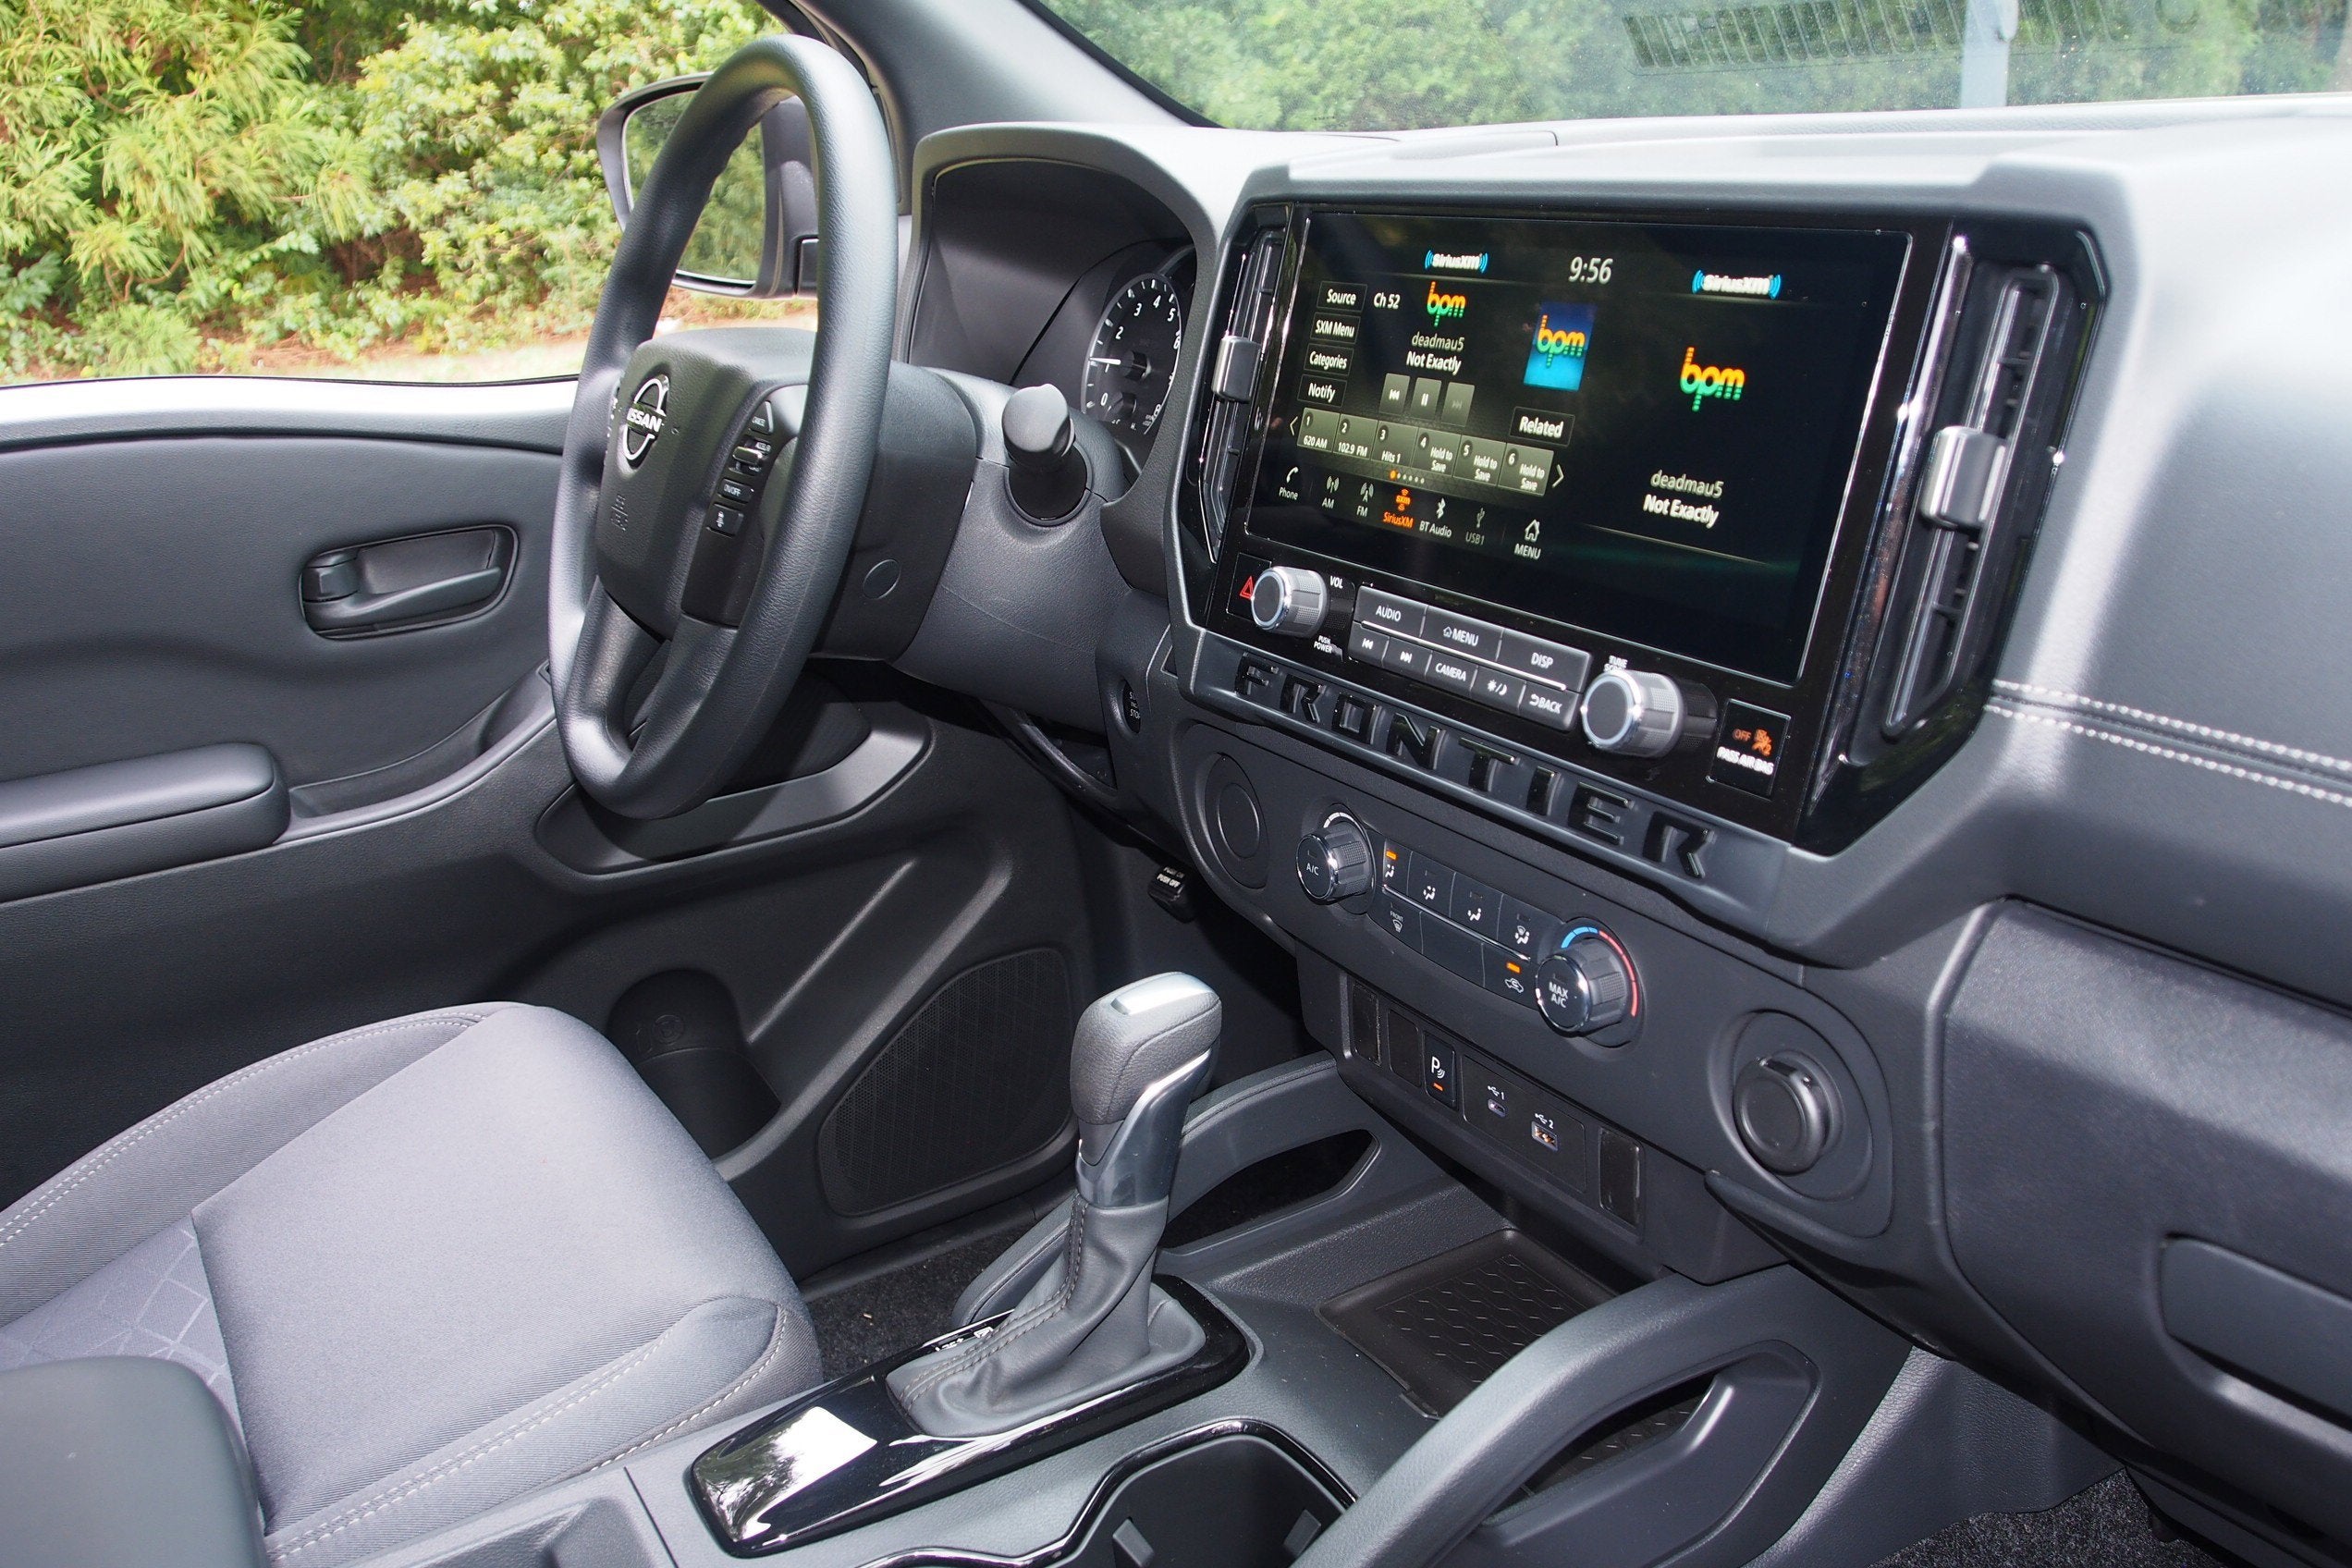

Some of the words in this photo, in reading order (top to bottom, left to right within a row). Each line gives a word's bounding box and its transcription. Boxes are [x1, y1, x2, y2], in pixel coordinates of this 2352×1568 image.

[1568, 256, 1613, 285] 9:56
[1152, 295, 1161, 309] 4
[1326, 288, 1357, 306] Source
[1373, 292, 1387, 307] Ch
[1387, 294, 1401, 310] 52
[1427, 281, 1467, 327] bpm
[1133, 302, 1142, 316] 3
[1167, 307, 1176, 322] 5
[1115, 325, 1123, 339] 2
[1315, 319, 1333, 334] SXM
[1333, 322, 1355, 337] Menu
[1173, 336, 1181, 349] 6
[1411, 331, 1464, 351] deadmau5
[1536, 314, 1586, 368] bpm
[1309, 350, 1347, 371] Categories
[1406, 351, 1427, 368] Not
[1427, 353, 1462, 375] Exactly
[1680, 346, 1746, 412] bpm
[1100, 392, 1109, 406] 0
[1307, 382, 1336, 400] Notify
[1305, 415, 1311, 426] 1
[1341, 423, 1348, 434] 2
[1519, 415, 1564, 440] Related
[1303, 435, 1316, 447] 620
[1315, 437, 1328, 449] AM
[1379, 429, 1386, 440] 3
[1420, 436, 1427, 448] 4
[1338, 442, 1355, 454] 102.9
[1356, 445, 1368, 458] FM
[1381, 450, 1396, 463] Hits
[1396, 453, 1401, 464] 1
[1430, 447, 1446, 459] Hold
[1445, 449, 1453, 461] to
[1463, 444, 1470, 457] 5
[1430, 459, 1447, 472] Save
[1473, 454, 1489, 469] Hold
[1488, 458, 1498, 470] to
[1508, 452, 1515, 465] 6
[1474, 469, 1491, 482] Save
[1519, 463, 1537, 477] Hold
[1536, 467, 1546, 480] to
[1520, 477, 1538, 492] Save
[1650, 469, 1724, 498] deadmau5
[1279, 486, 1299, 500] Phone
[1321, 497, 1335, 509] AM
[1356, 505, 1368, 518] FM
[1642, 494, 1669, 515] Not
[1670, 499, 1719, 529] Exactly
[1382, 511, 1414, 529] SiriusXM
[1419, 521, 1430, 533] BT
[1430, 522, 1452, 538] Audio
[1514, 544, 1541, 560] MENU
[1329, 575, 1343, 590] VOL
[1376, 605, 1402, 622] AUDIO
[1317, 635, 1331, 645] PUSH
[1452, 628, 1479, 647] MENU
[1314, 641, 1333, 654] POWER
[1531, 652, 1554, 668] DISP
[1435, 662, 1467, 681] CAMERA
[1537, 697, 1562, 715] BACK
[1733, 728, 1752, 742] OFF
[1234, 651, 1713, 878] FRONTIER
[1305, 862, 1319, 876] A/C
[1549, 981, 1569, 999] MAX
[1550, 993, 1567, 1009] A/C
